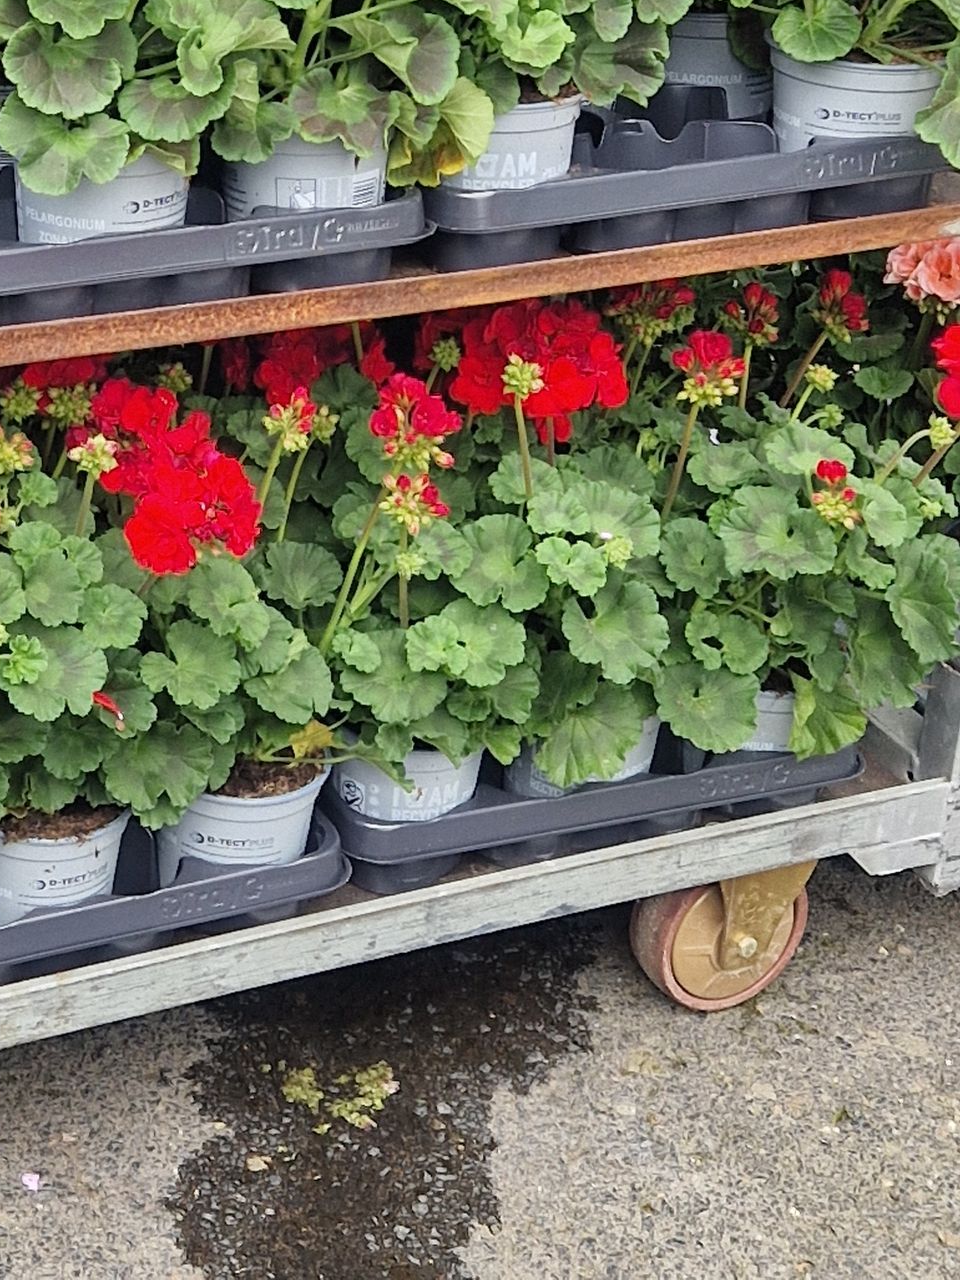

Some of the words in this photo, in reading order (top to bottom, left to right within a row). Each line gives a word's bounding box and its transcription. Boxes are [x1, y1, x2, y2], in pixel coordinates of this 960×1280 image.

[664, 70, 743, 86] ELARGONIUM
[832, 110, 873, 121] D-TECT
[499, 151, 537, 178] AM
[142, 195, 175, 209] D-TECT
[24, 206, 106, 231] PELARGONIUM
[427, 778, 461, 806] AM
[206, 835, 247, 847] D-TECT
[48, 873, 87, 887] D-TECT
